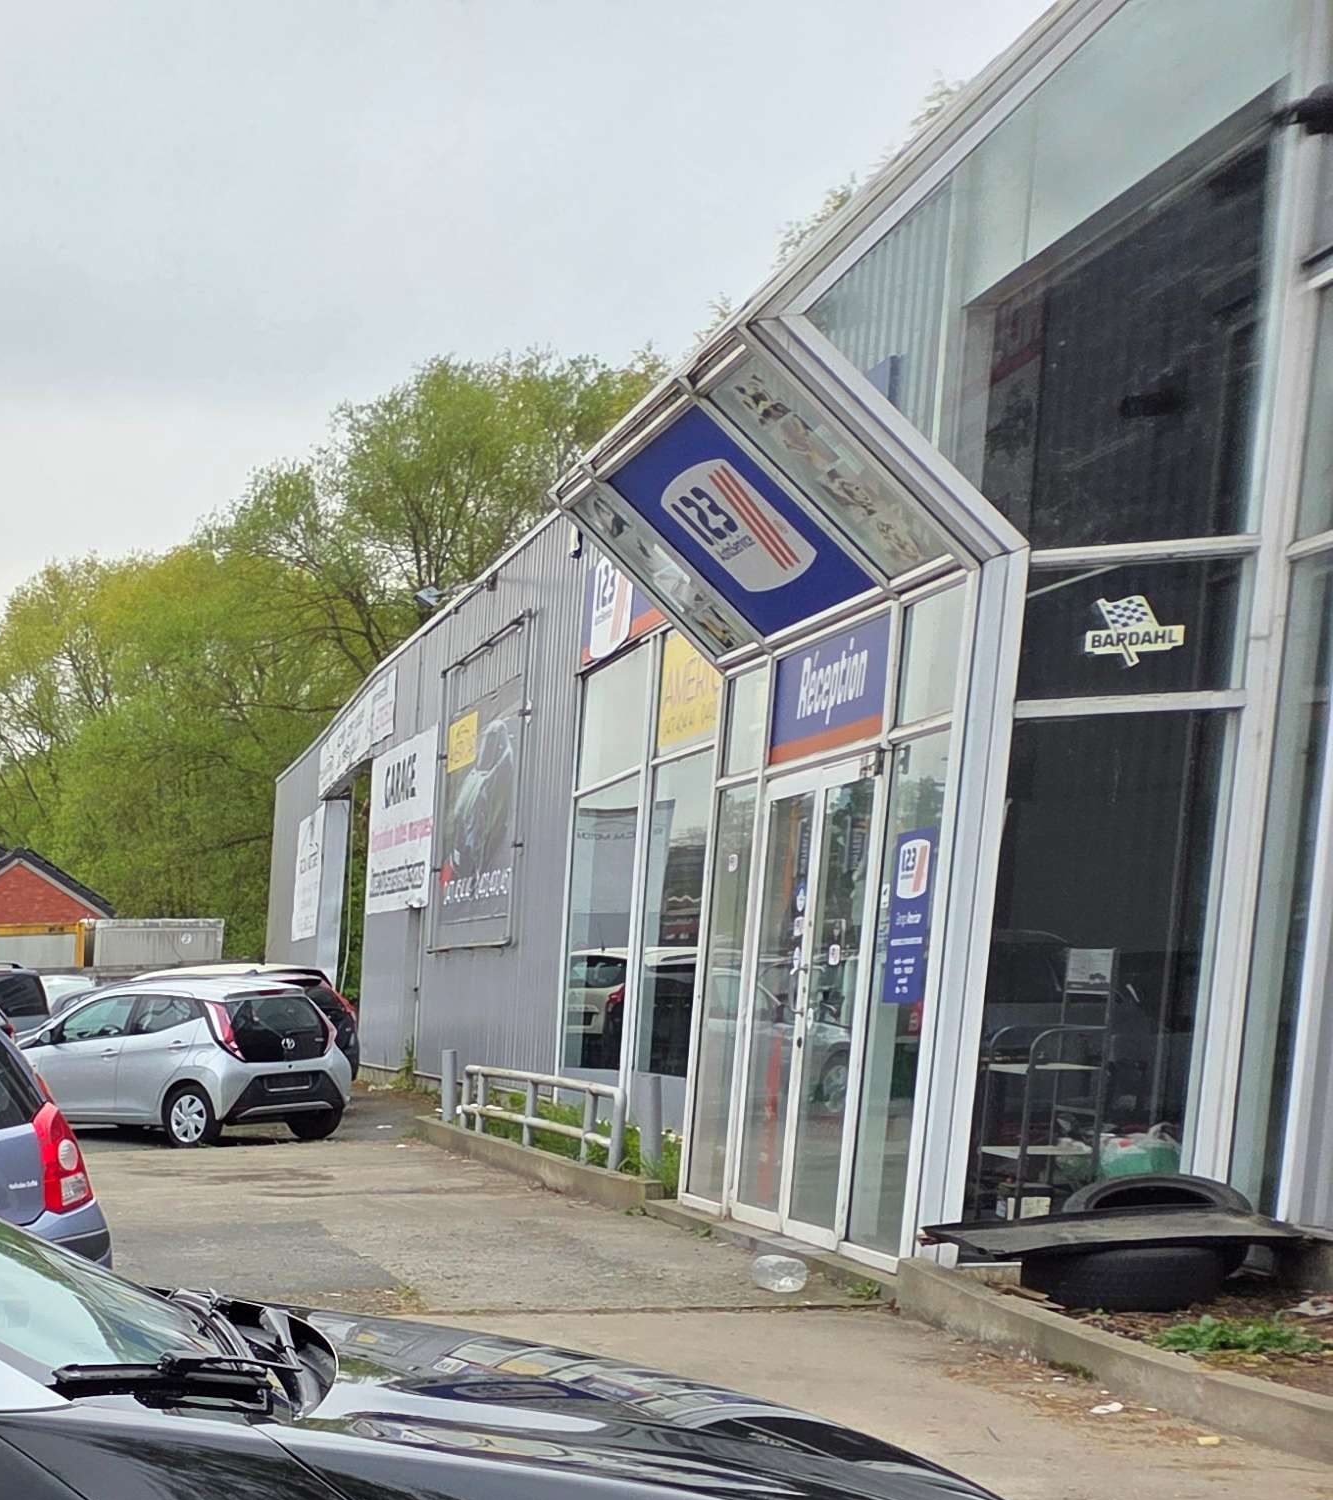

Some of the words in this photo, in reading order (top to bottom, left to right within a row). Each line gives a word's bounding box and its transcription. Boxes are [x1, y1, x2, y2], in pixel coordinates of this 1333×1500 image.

[671, 486, 738, 546] 123
[1091, 629, 1178, 648] BARDAHL
[796, 637, 868, 725] Réception
[901, 847, 917, 872] 123
